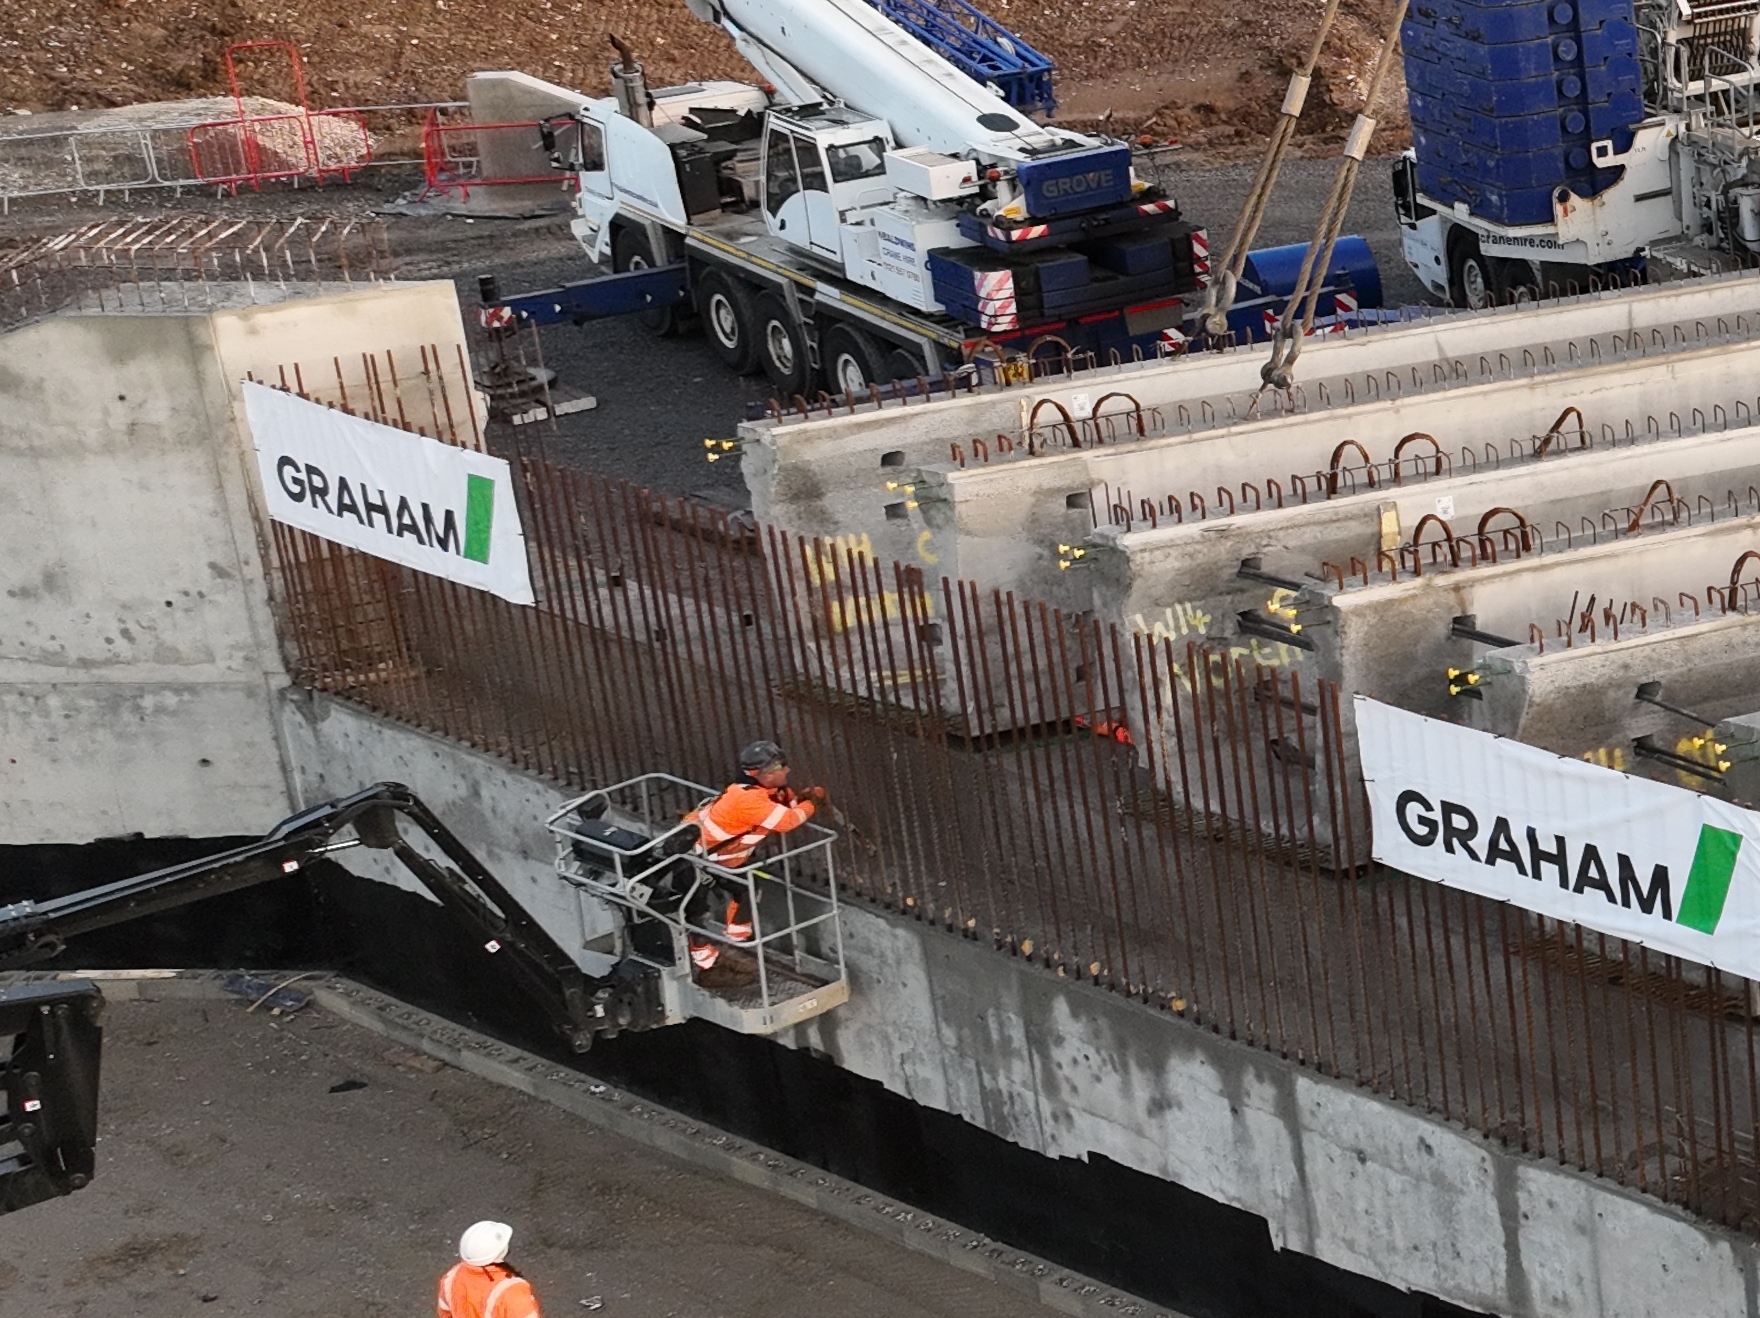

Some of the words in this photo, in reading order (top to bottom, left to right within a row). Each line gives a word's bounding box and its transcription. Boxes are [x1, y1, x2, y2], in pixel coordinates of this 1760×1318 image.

[1042, 169, 1115, 198] GROVE
[276, 455, 462, 556] GRAHAM
[1395, 788, 1674, 922] GRAHAM
